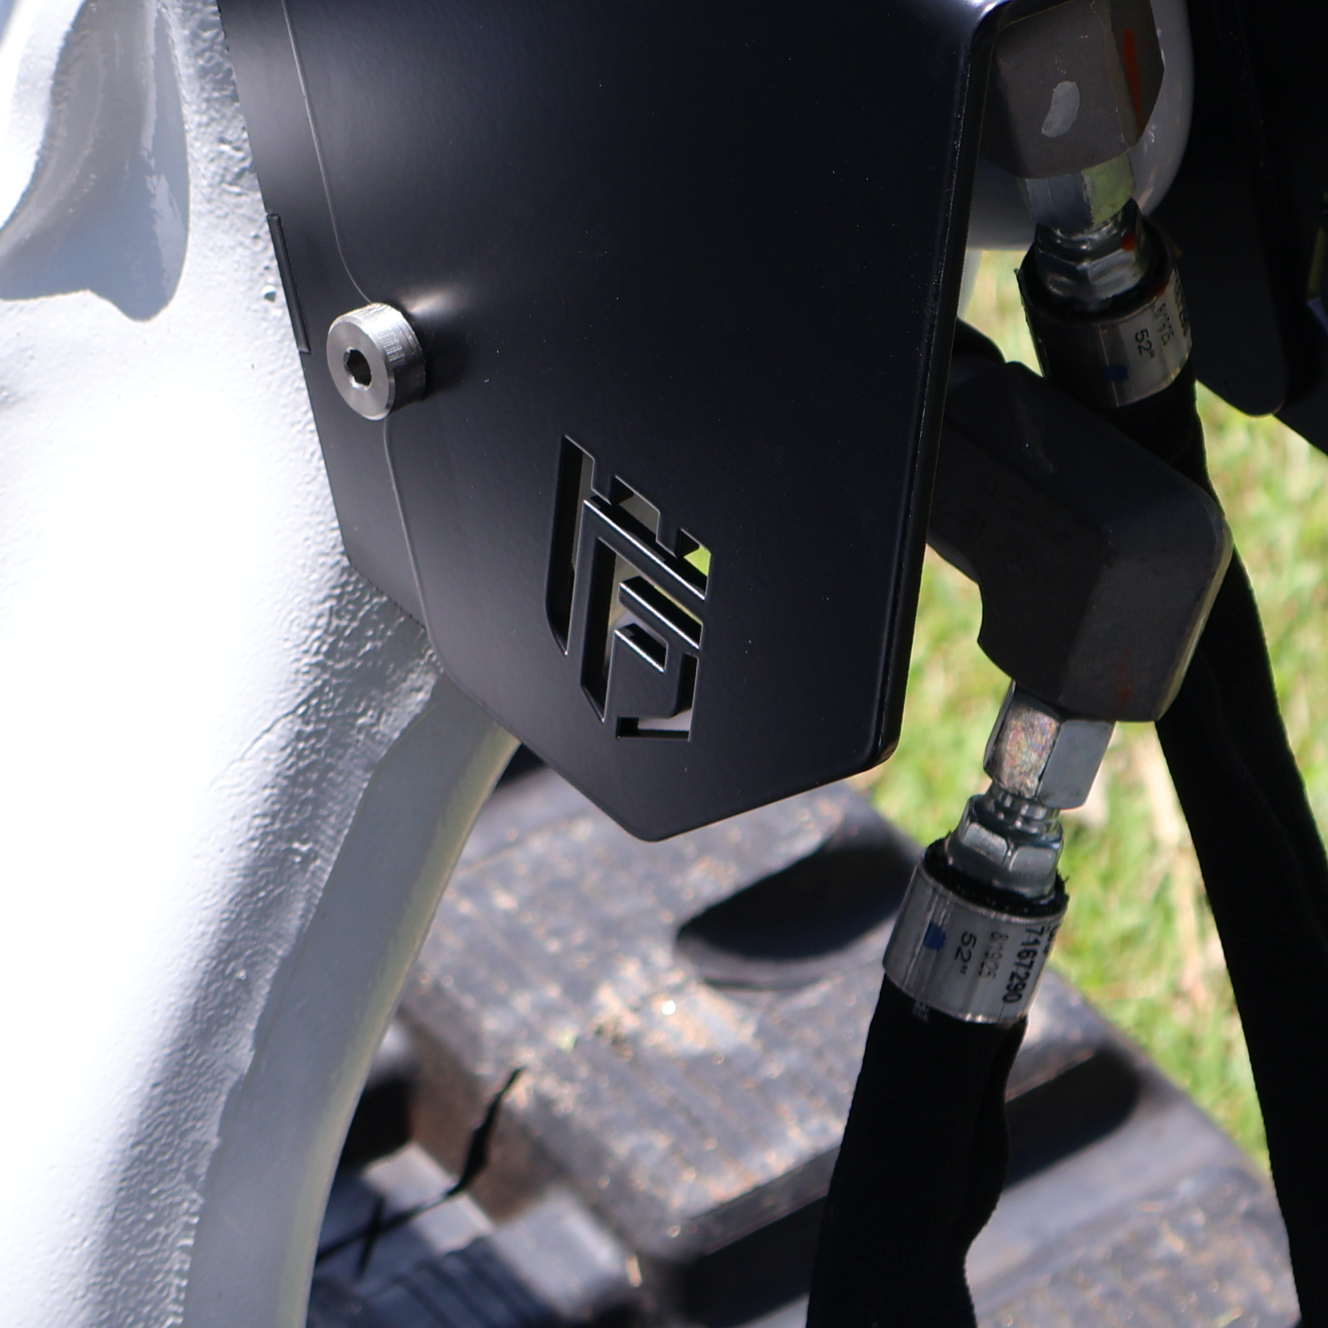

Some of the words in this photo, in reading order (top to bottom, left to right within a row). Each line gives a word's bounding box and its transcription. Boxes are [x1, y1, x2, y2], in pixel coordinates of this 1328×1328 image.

[1134, 328, 1156, 359] 52"
[954, 931, 977, 975] 52"
[1002, 926, 1046, 1004] 7167290
